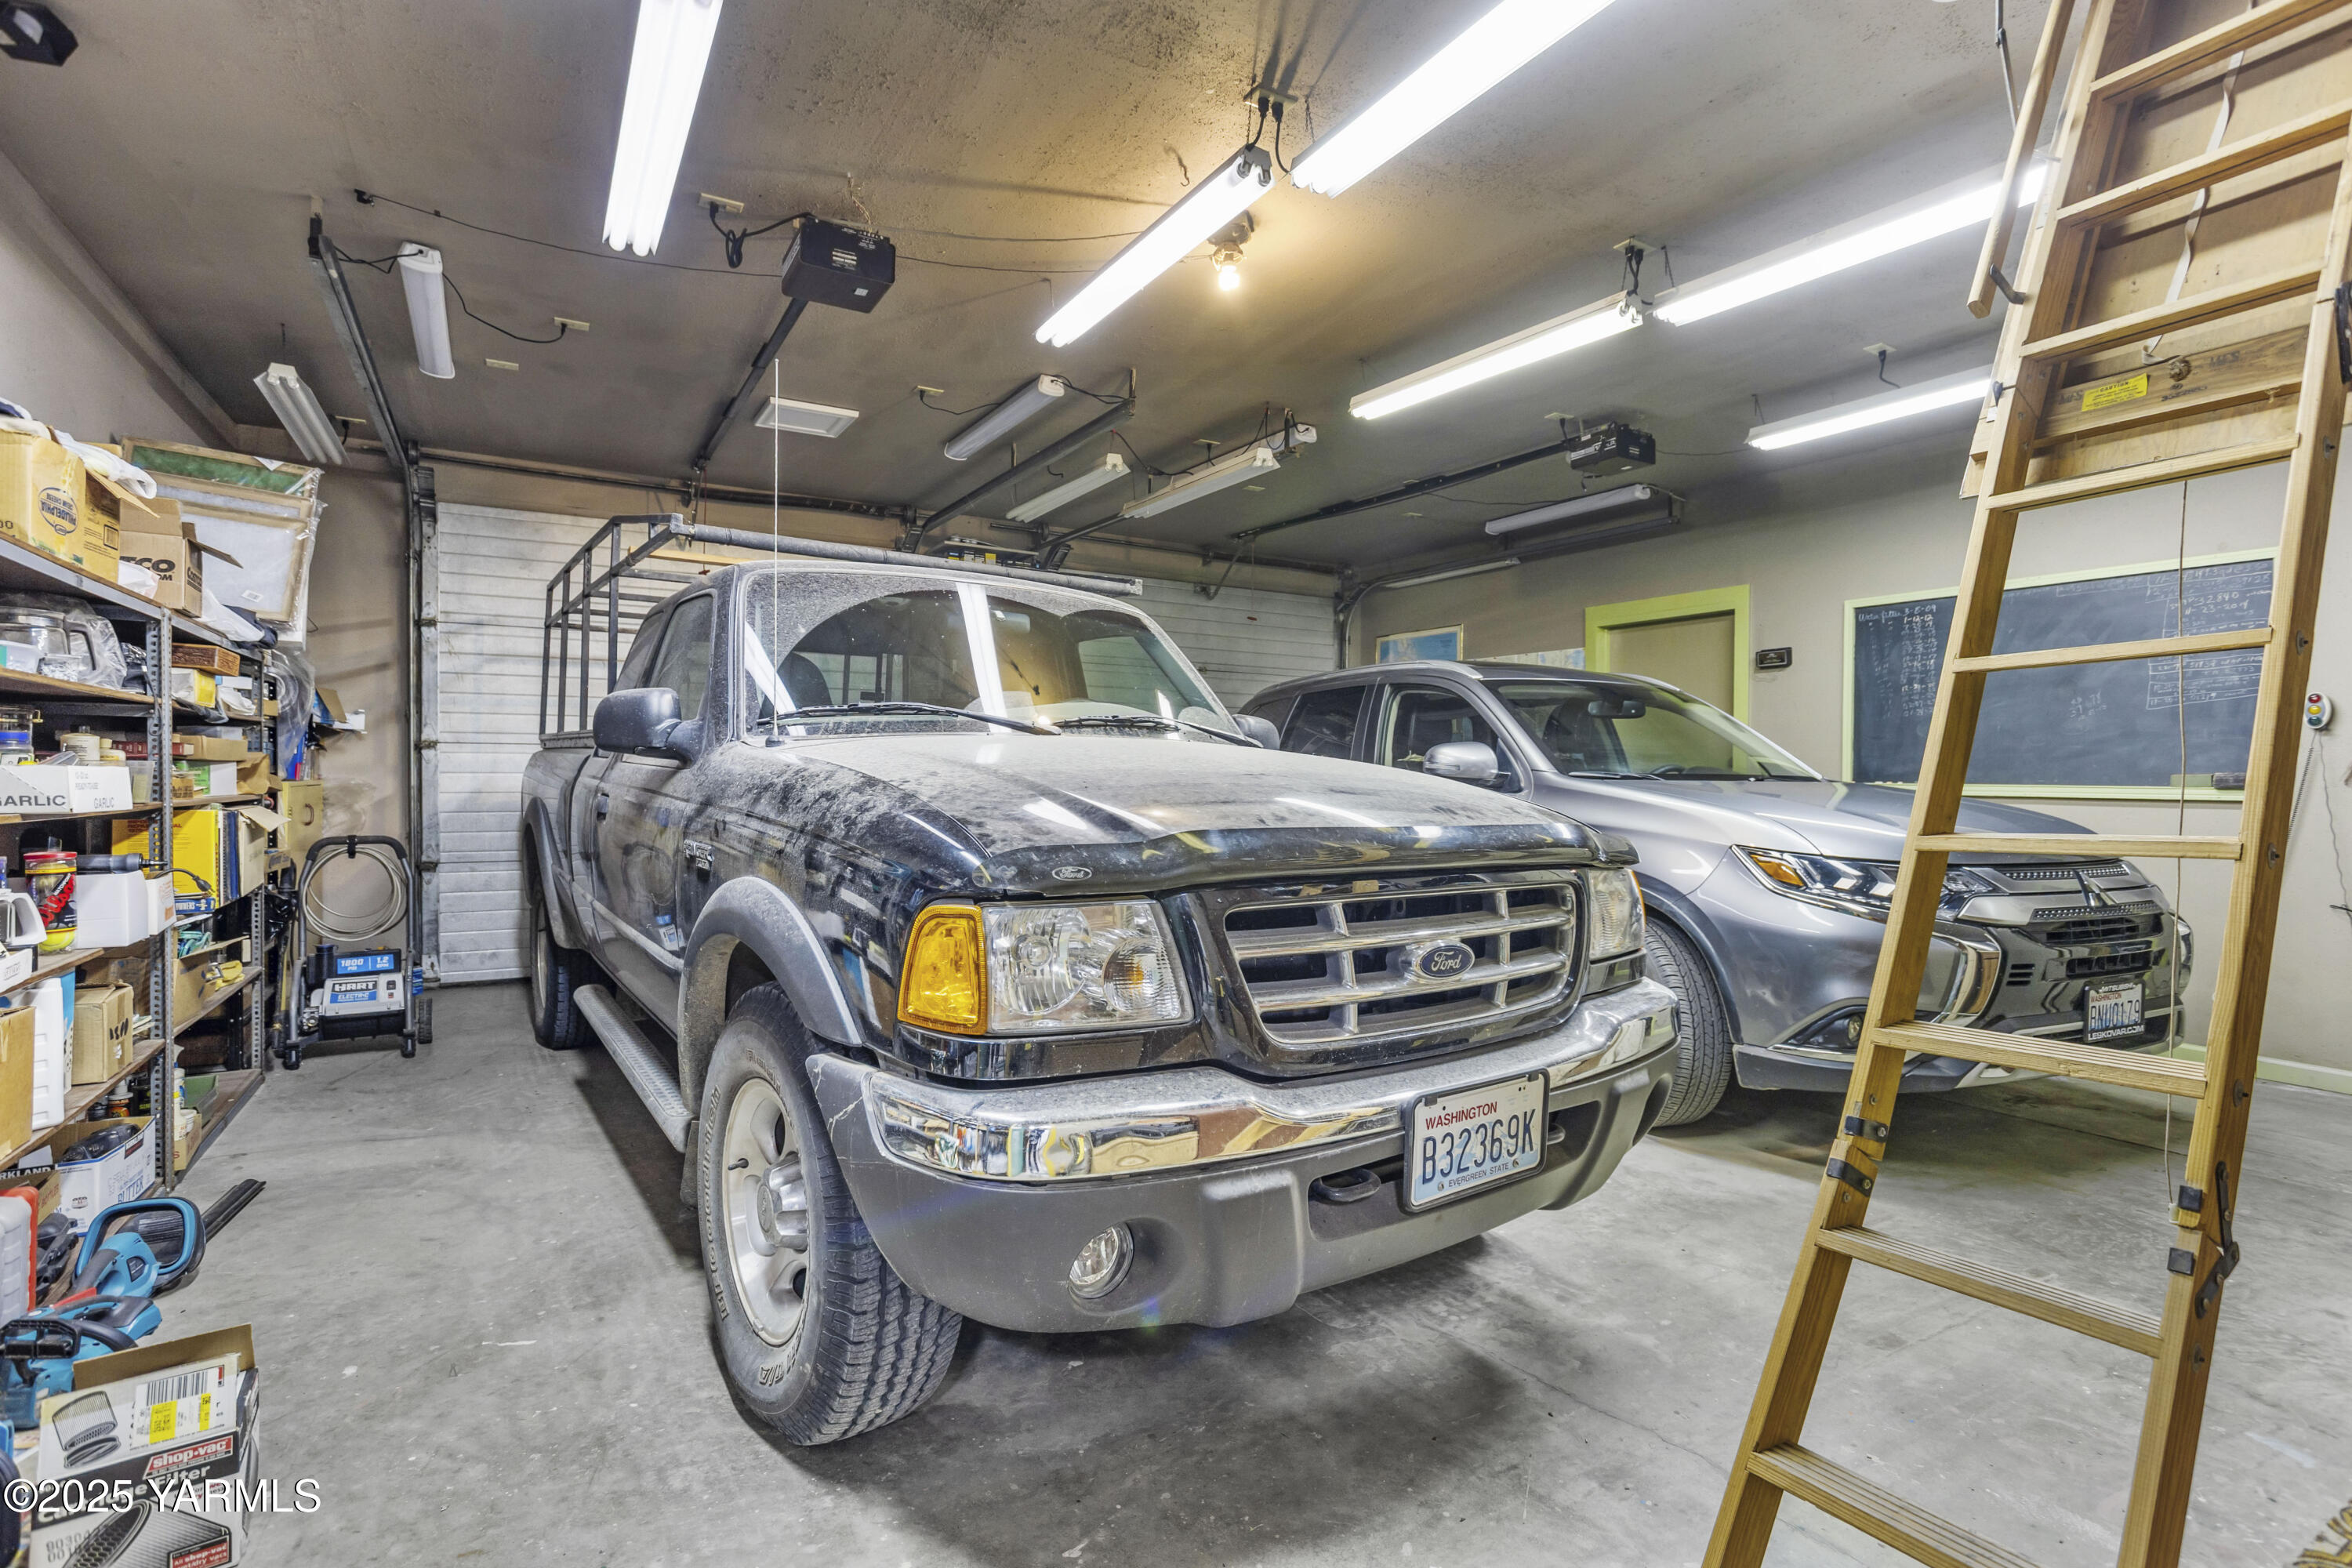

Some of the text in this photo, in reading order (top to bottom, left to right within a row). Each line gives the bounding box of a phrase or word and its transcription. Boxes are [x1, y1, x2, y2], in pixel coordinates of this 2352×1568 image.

[0, 795, 67, 806] ARLIC
[1059, 867, 1084, 878] Ford
[341, 959, 365, 967] 1800
[1431, 951, 1462, 971] Ford
[335, 982, 376, 992] HART
[2090, 992, 2122, 1003] WASHINGTON
[2088, 1025, 2144, 1040] LESKOVAR.COM
[1425, 1101, 1498, 1131] WASHINGTON
[1422, 1109, 1536, 1185] B32369K
[1448, 1163, 1510, 1188] EVERGREEN STATE
